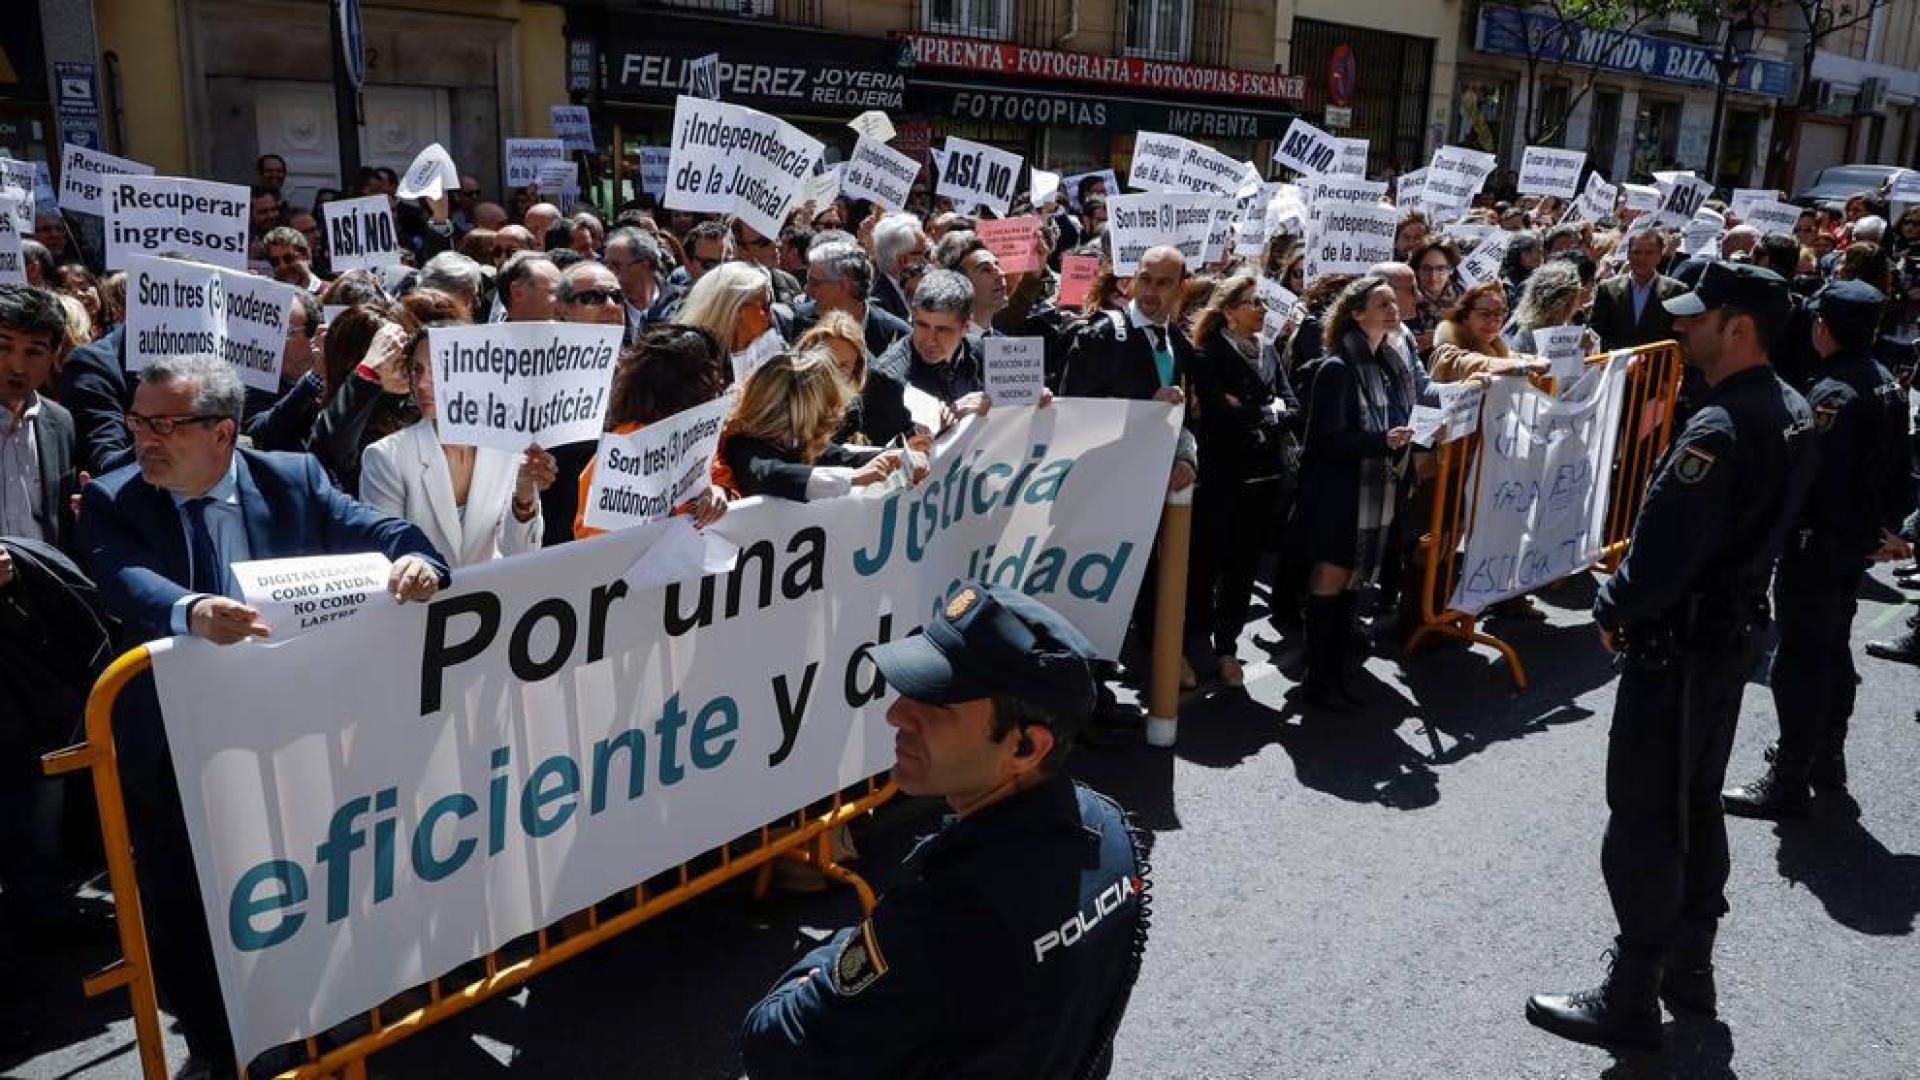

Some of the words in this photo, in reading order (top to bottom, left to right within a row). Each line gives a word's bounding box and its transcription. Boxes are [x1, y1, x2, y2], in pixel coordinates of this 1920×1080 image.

[621, 54, 691, 88] FELI
[719, 62, 807, 96] PEREZ
[812, 68, 905, 90] JOYERIA
[908, 37, 1003, 70] MPRENTA
[1018, 48, 1130, 82] FOTOGRAFIA
[1142, 63, 1236, 93] FOTOCOPIAS
[1242, 74, 1304, 99] ESCANER
[812, 87, 903, 108] RELOJERIA
[953, 93, 1107, 125] FOTOCOPIAS
[1168, 110, 1258, 137] IMPRENTA
[681, 112, 810, 179] ¡Independencia
[112, 184, 246, 218] ¡Recuperar
[677, 161, 702, 193] de
[705, 164, 723, 194] la
[725, 165, 791, 219] Justicia!
[331, 207, 364, 257] ASÍ,
[364, 211, 397, 252] NO.
[1115, 207, 1137, 229] Son
[1138, 208, 1157, 228] tres
[113, 221, 245, 253] ingresos!
[1322, 242, 1337, 261] de
[1340, 242, 1352, 261] la
[139, 272, 170, 308] Son
[173, 277, 205, 308] tres
[208, 275, 225, 318] (3)
[226, 288, 283, 334] poderes,
[139, 322, 218, 359] autónomos,
[443, 336, 612, 384] ¡Independencia
[448, 391, 478, 425] de
[486, 391, 506, 429] la
[514, 387, 604, 433] Justicia!
[608, 447, 641, 476] Son
[643, 445, 666, 476] tres
[271, 583, 319, 602] COMO
[294, 601, 317, 616] NO
[320, 593, 366, 610] COMO
[421, 578, 629, 717] Por
[664, 526, 827, 636] una
[228, 691, 739, 952] eficiente
[768, 662, 820, 767] y
[933, 534, 1135, 617] lidad
